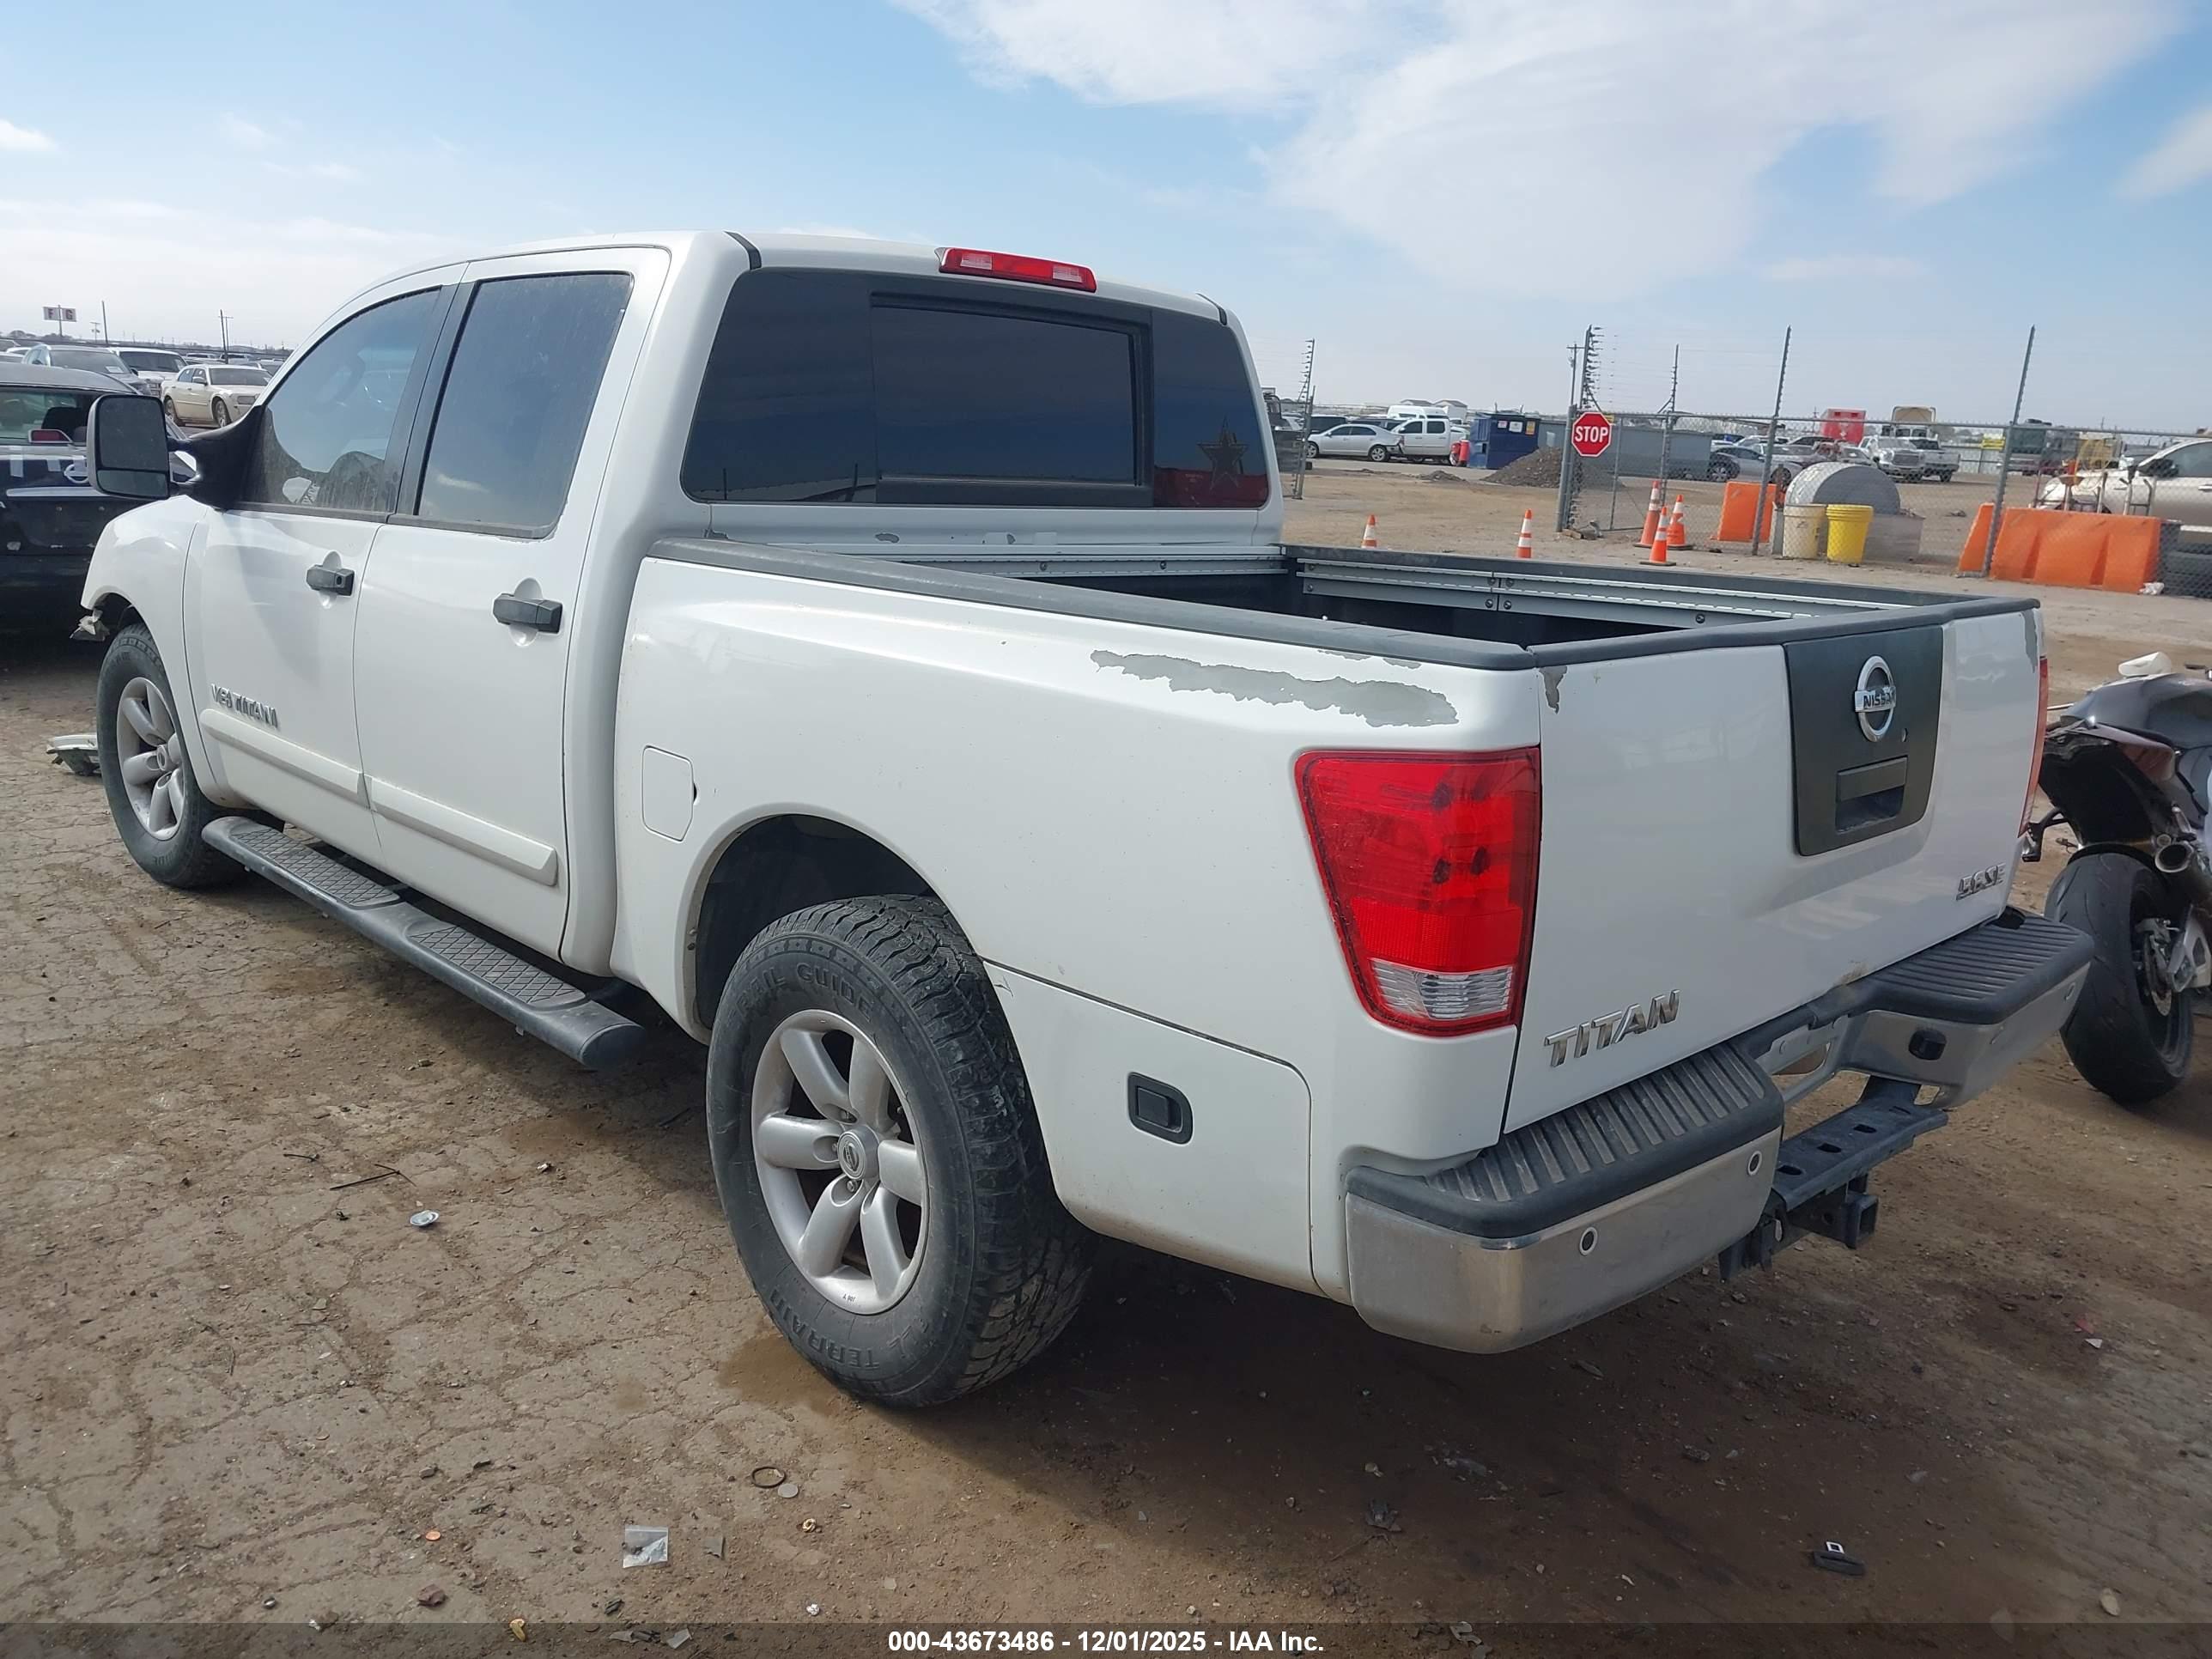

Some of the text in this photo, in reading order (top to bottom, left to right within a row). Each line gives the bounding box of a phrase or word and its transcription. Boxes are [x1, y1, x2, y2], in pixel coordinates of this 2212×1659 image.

[1575, 426, 1609, 443] STOP
[233, 692, 279, 729] TITAN
[796, 962, 874, 1024] GUIDE
[1544, 989, 1680, 1067] TITAN
[769, 1289, 880, 1370] TERRAIN
